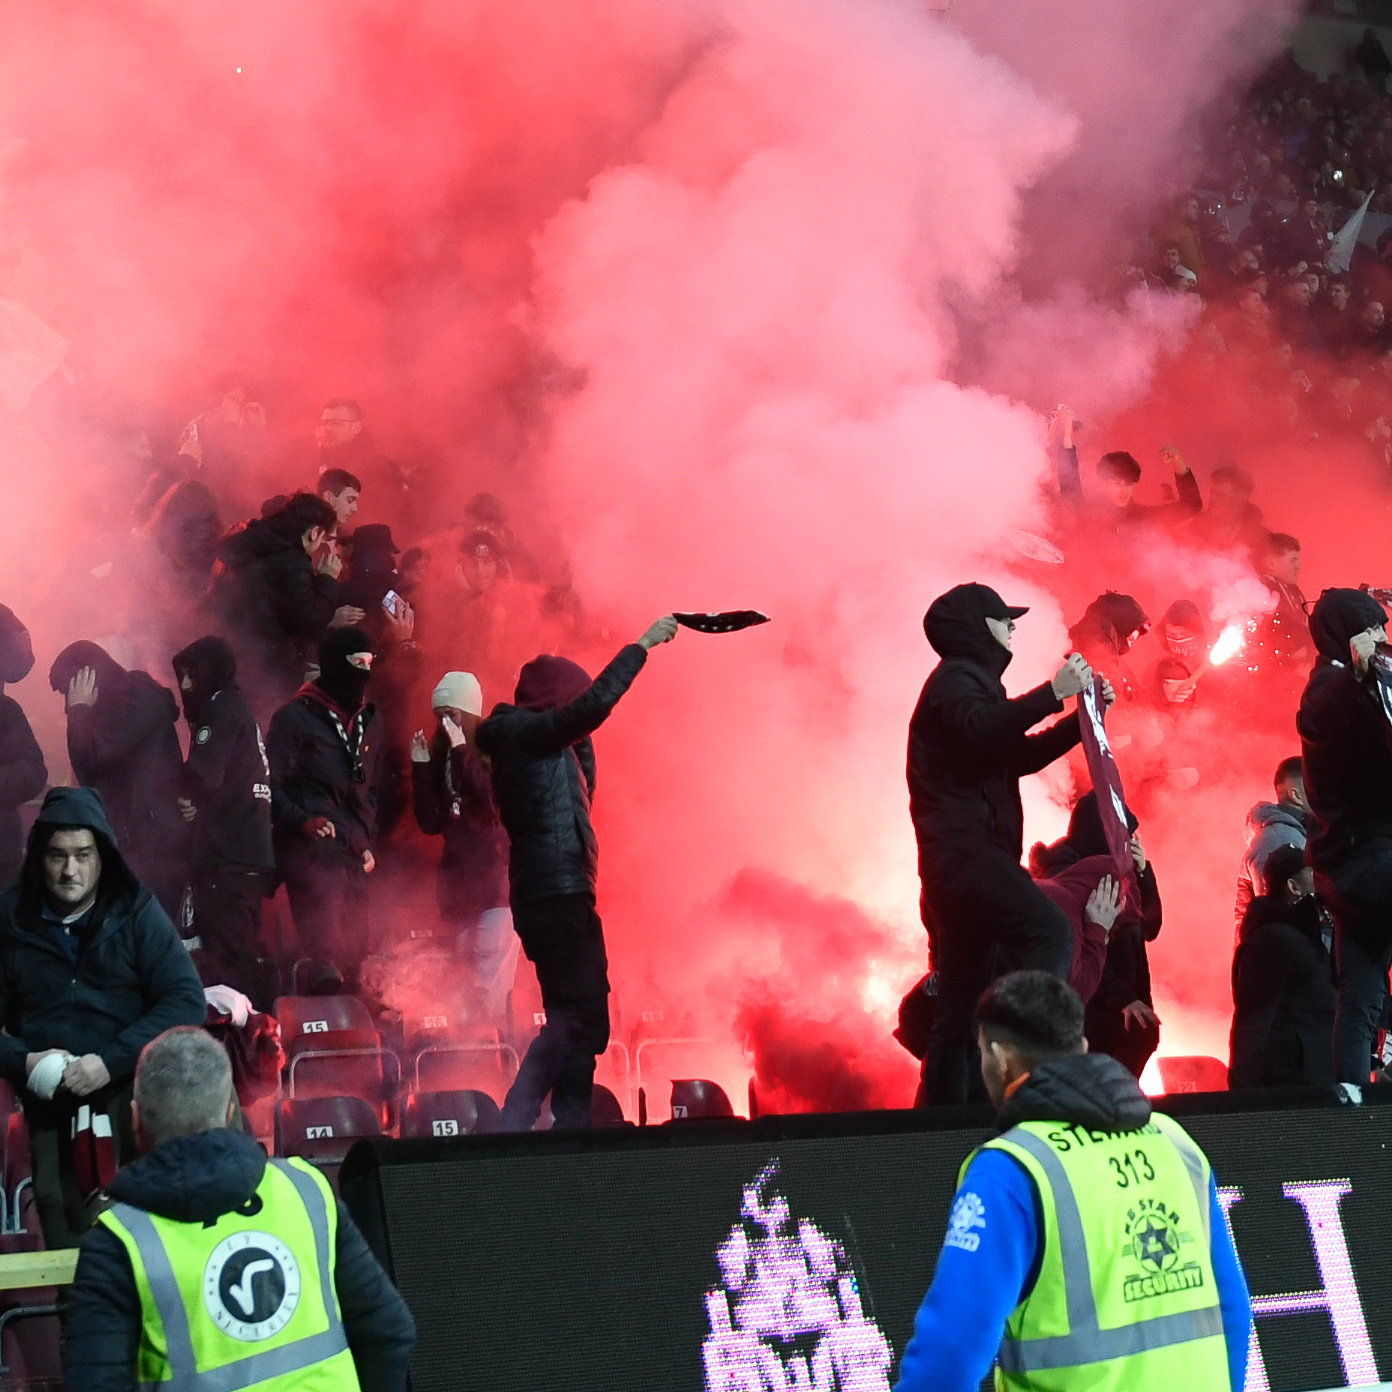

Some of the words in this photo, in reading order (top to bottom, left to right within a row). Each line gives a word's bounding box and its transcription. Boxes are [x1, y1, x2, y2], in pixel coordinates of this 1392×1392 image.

[307, 1022, 323, 1033] 15
[310, 1127, 328, 1139] 14
[436, 1121, 454, 1136] 15
[1109, 1149, 1155, 1188] 313
[1124, 1267, 1202, 1302] SECURITY
